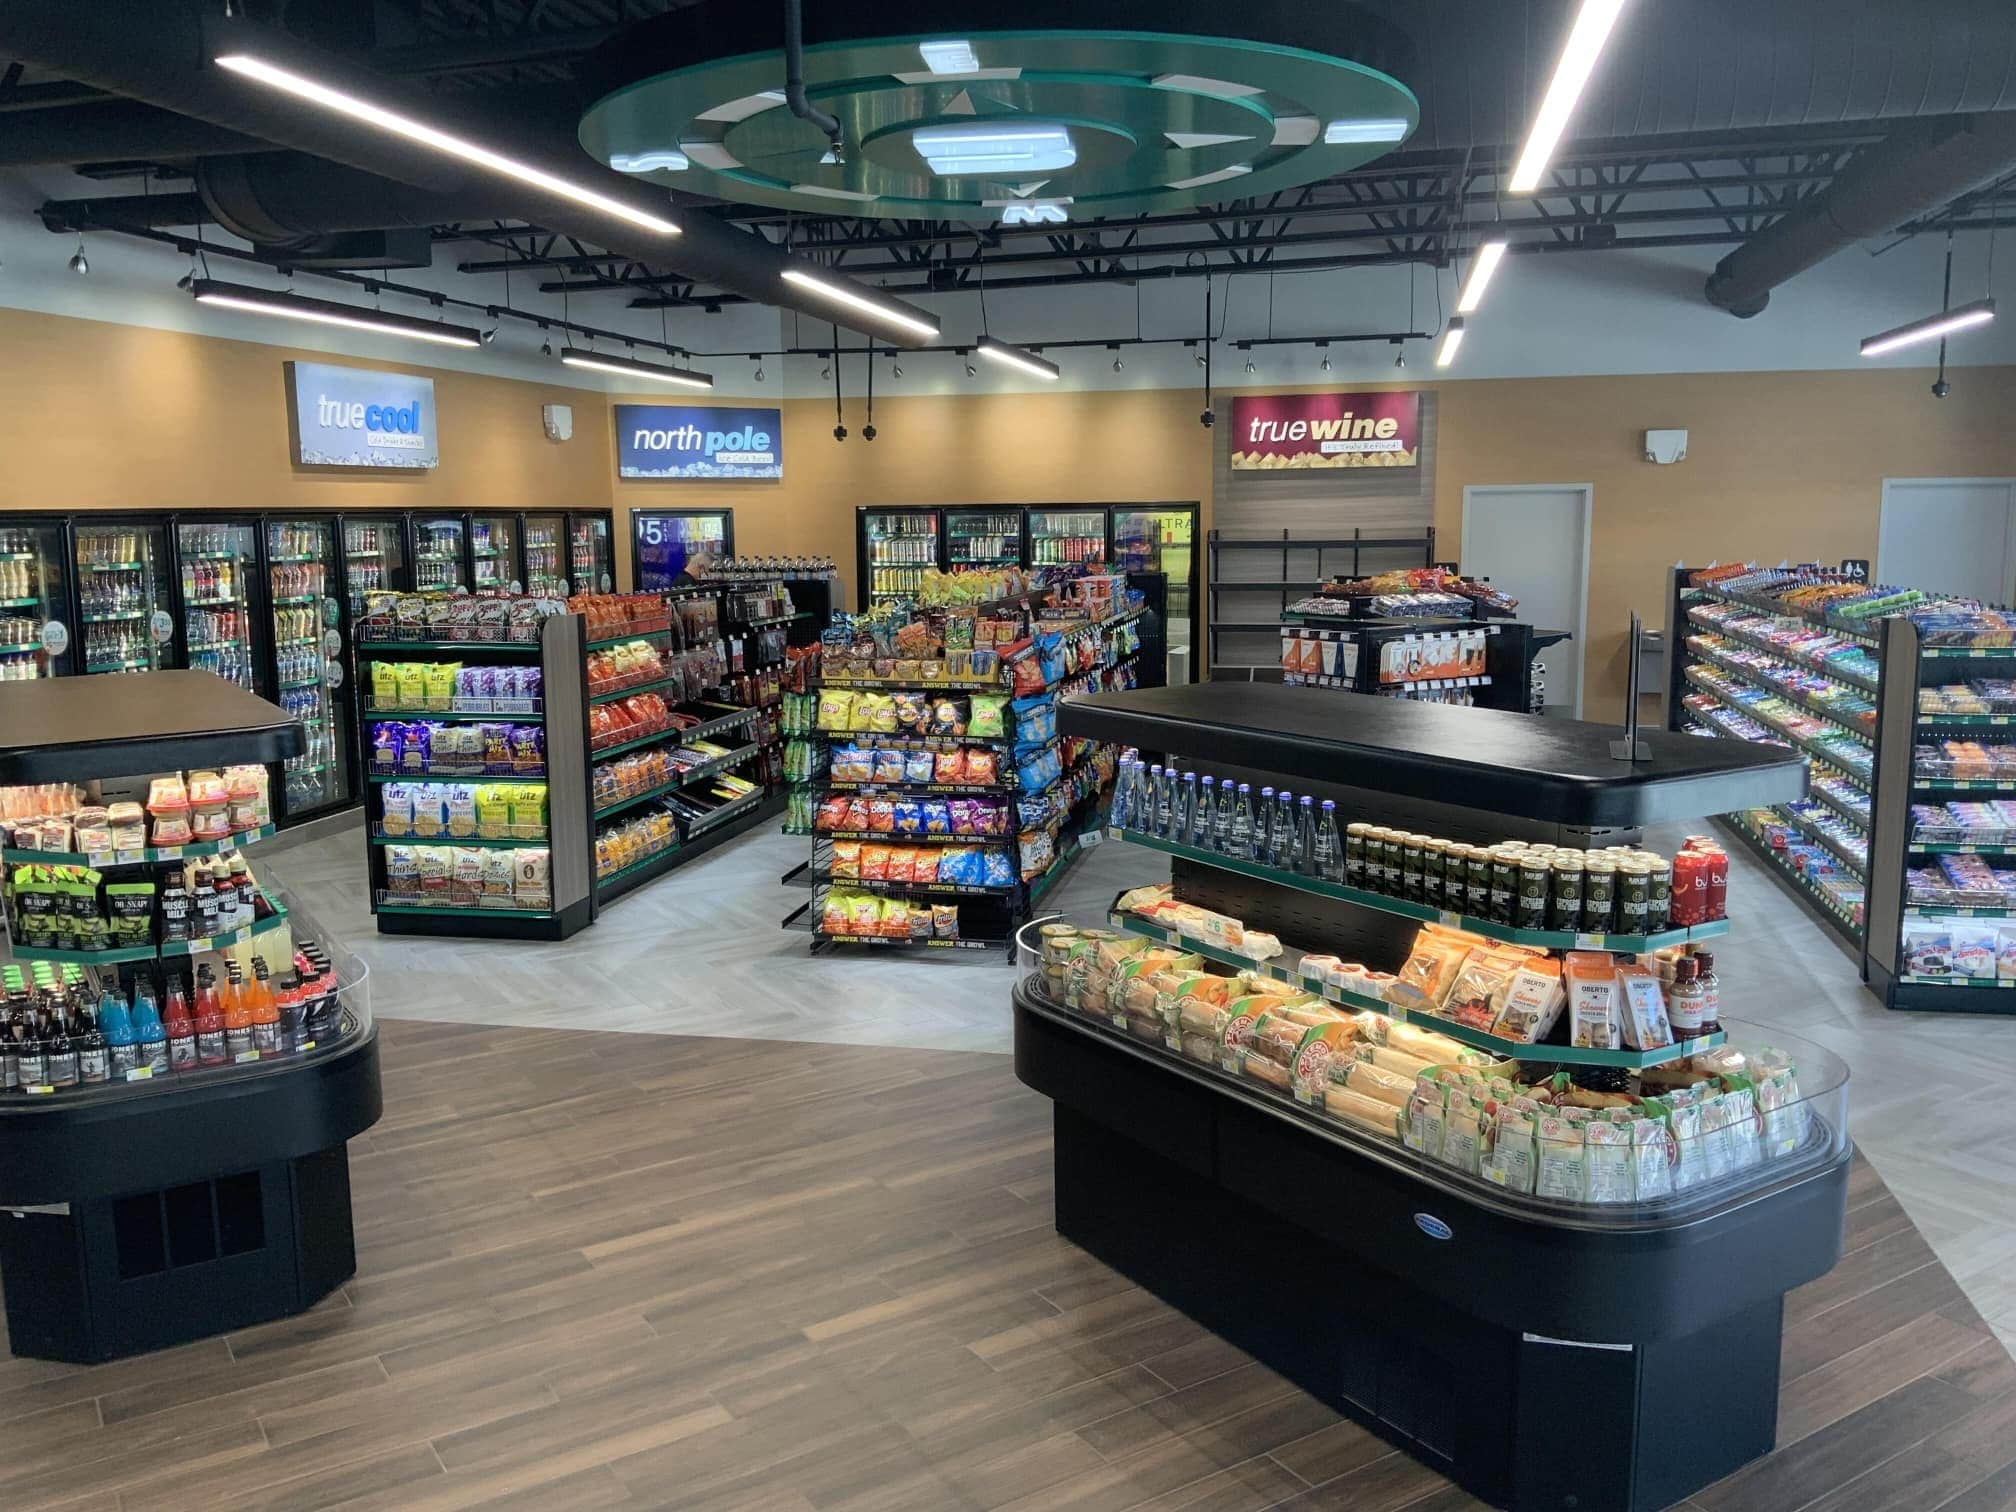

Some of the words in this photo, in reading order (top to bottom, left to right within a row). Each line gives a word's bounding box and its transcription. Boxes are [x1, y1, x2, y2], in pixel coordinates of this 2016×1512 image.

[633, 424, 702, 450] north
[705, 425, 771, 456] pole
[197, 896, 218, 909] MUSC
[166, 908, 186, 919] MILK
[203, 907, 218, 917] MIL
[1522, 977, 1546, 988] OBERTO
[1581, 985, 1609, 993] OBERTO
[1680, 1001, 1703, 1010] DUN
